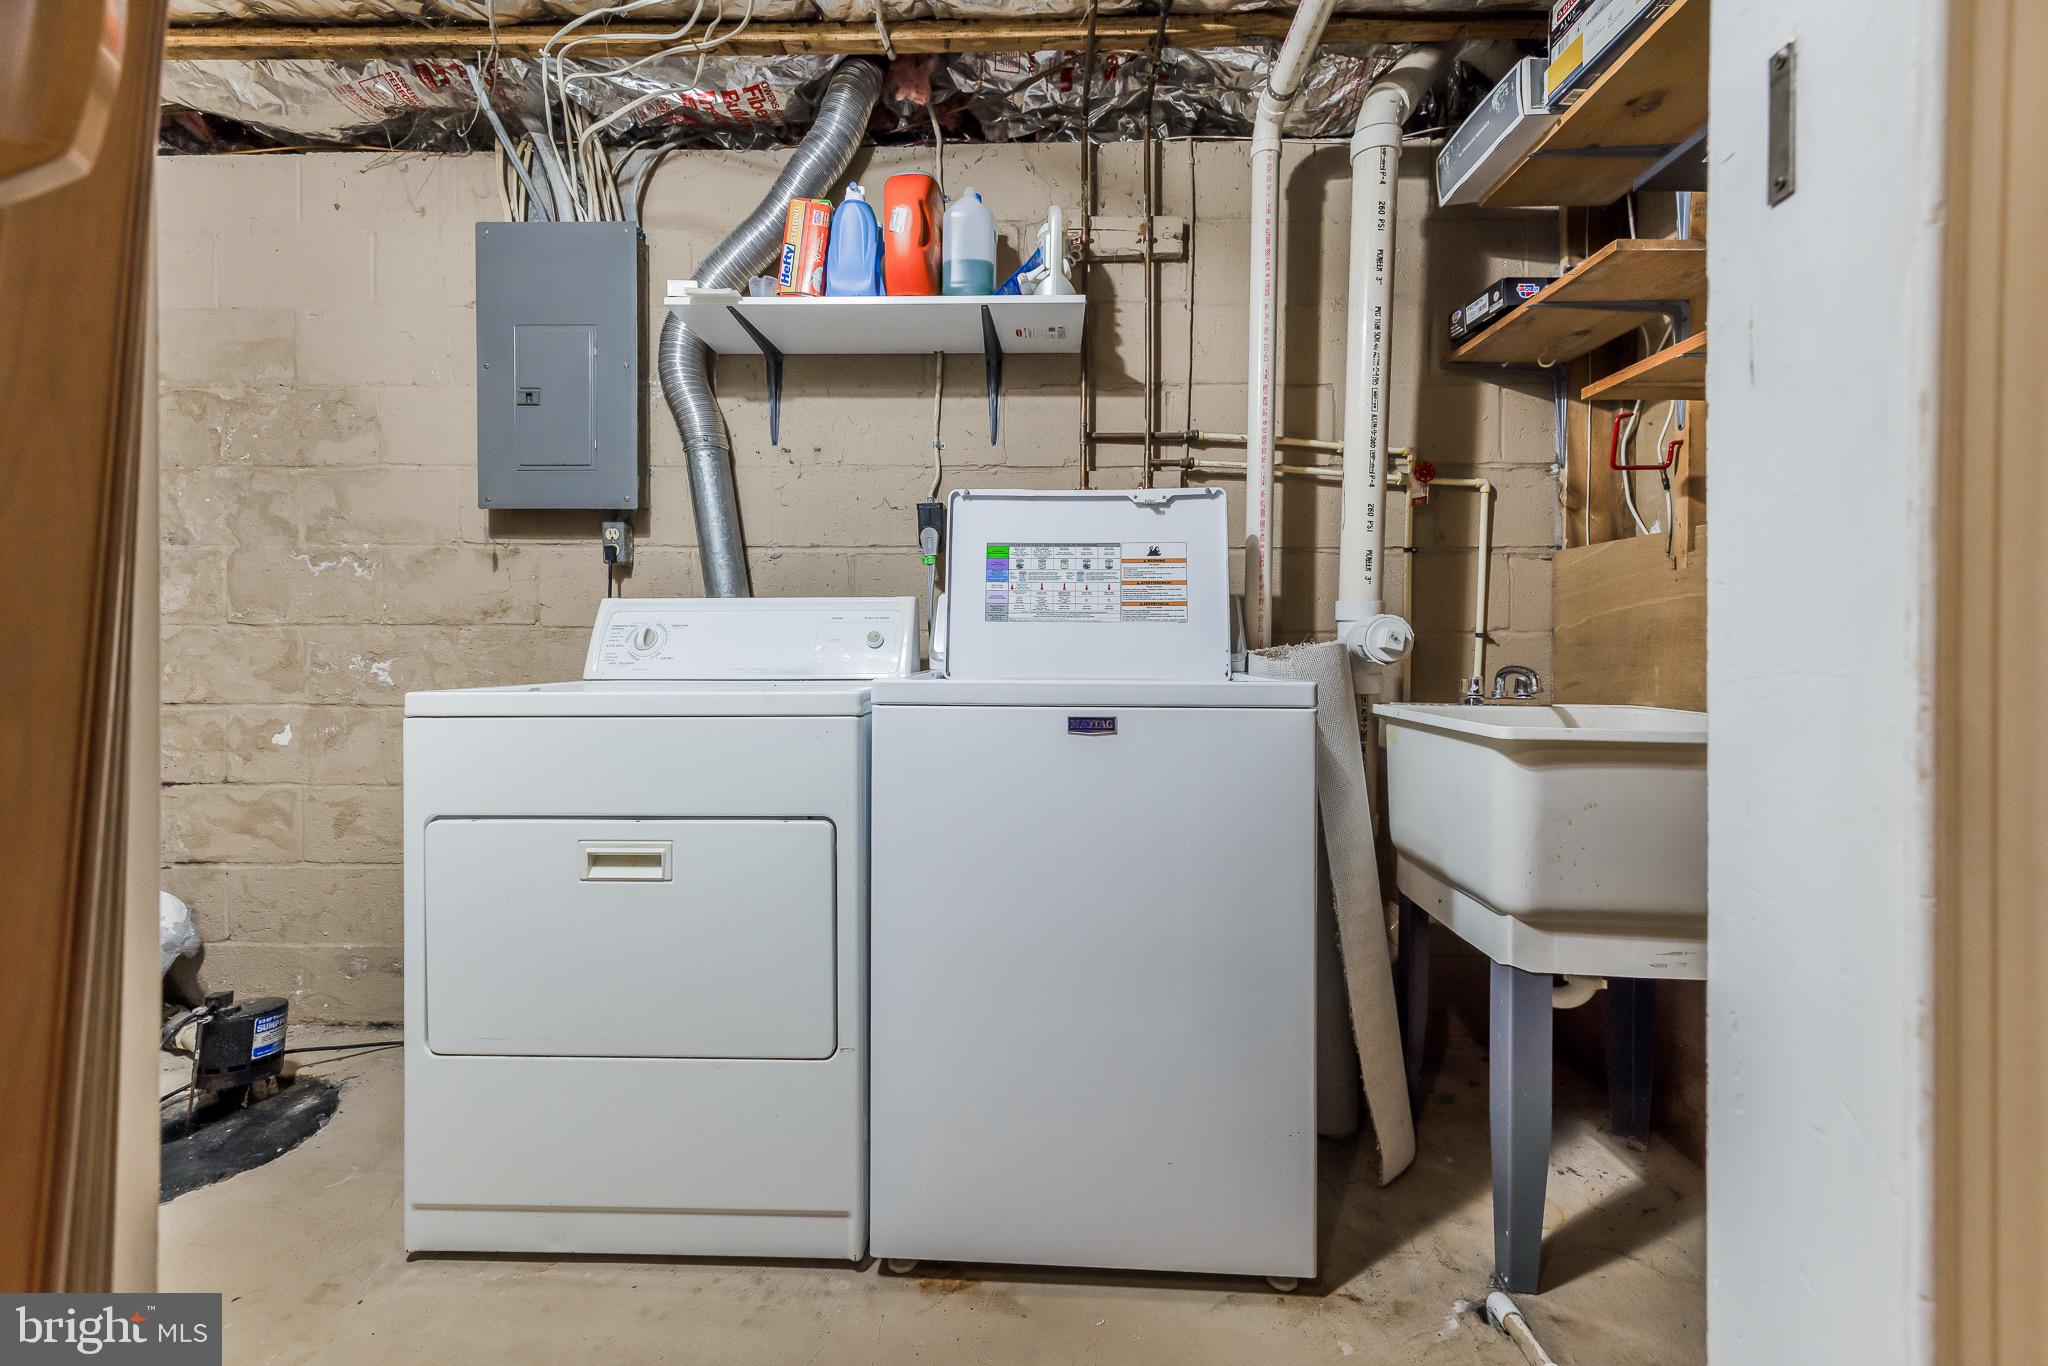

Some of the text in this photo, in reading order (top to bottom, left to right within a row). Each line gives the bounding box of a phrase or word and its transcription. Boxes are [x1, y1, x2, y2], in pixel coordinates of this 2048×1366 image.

[1377, 200, 1386, 215] 260
[791, 205, 801, 242] STRONG
[1377, 218, 1386, 231] PSI
[781, 246, 796, 284] Hefty
[1367, 503, 1375, 517] 260
[1069, 719, 1113, 729] MAYTAG
